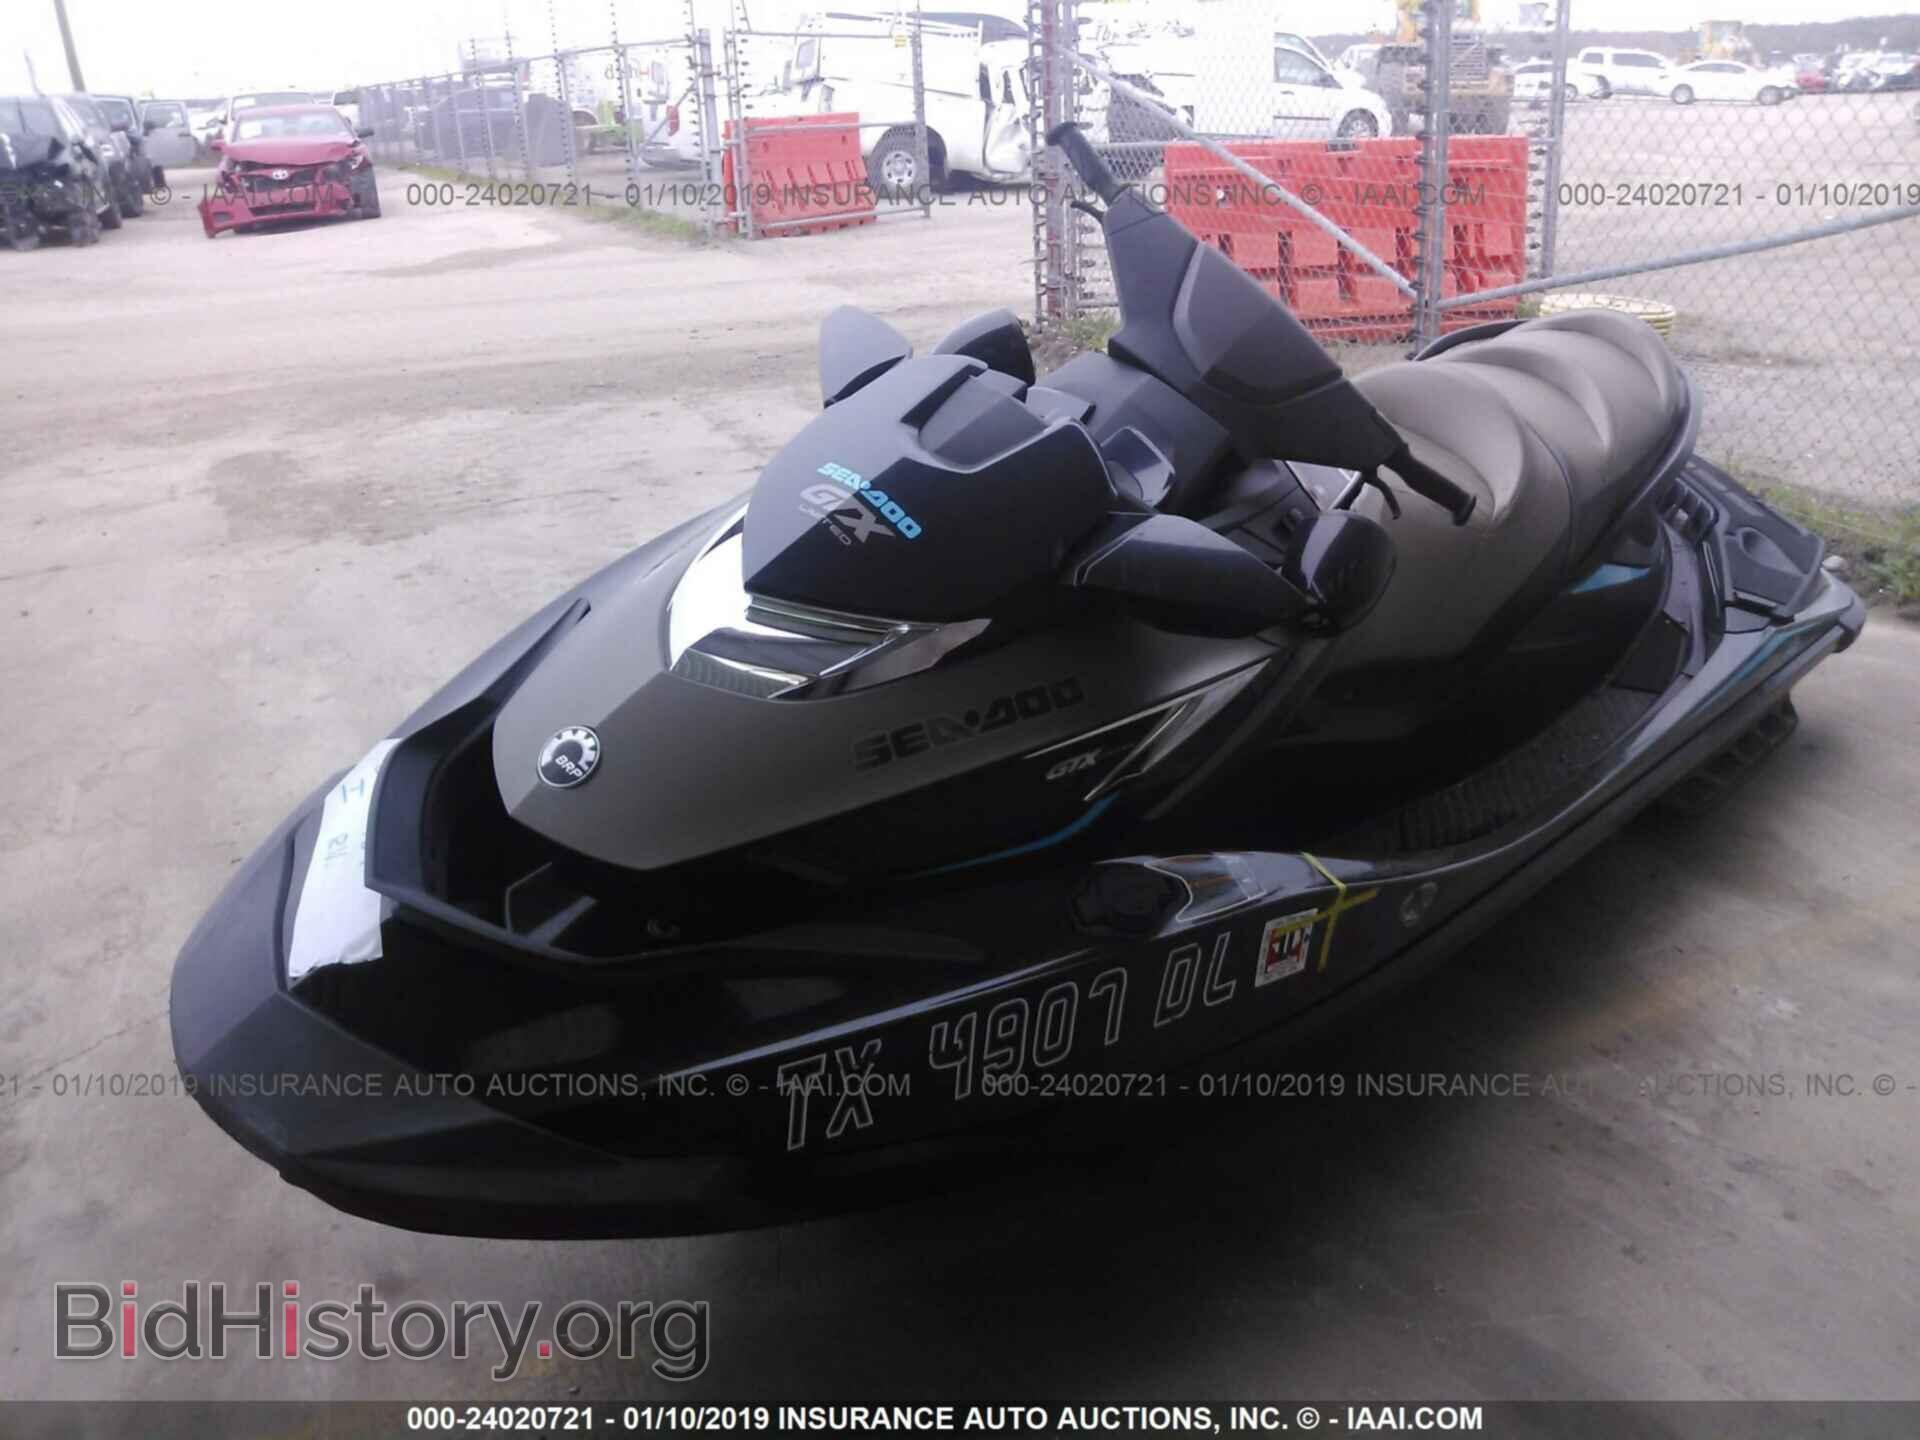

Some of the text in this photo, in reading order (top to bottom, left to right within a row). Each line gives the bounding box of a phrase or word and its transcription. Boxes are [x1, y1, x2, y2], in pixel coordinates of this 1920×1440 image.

[555, 754, 583, 777] BRP
[1046, 750, 1101, 780] GTX
[777, 1039, 882, 1151] TX
[1154, 931, 1237, 1029] DL
